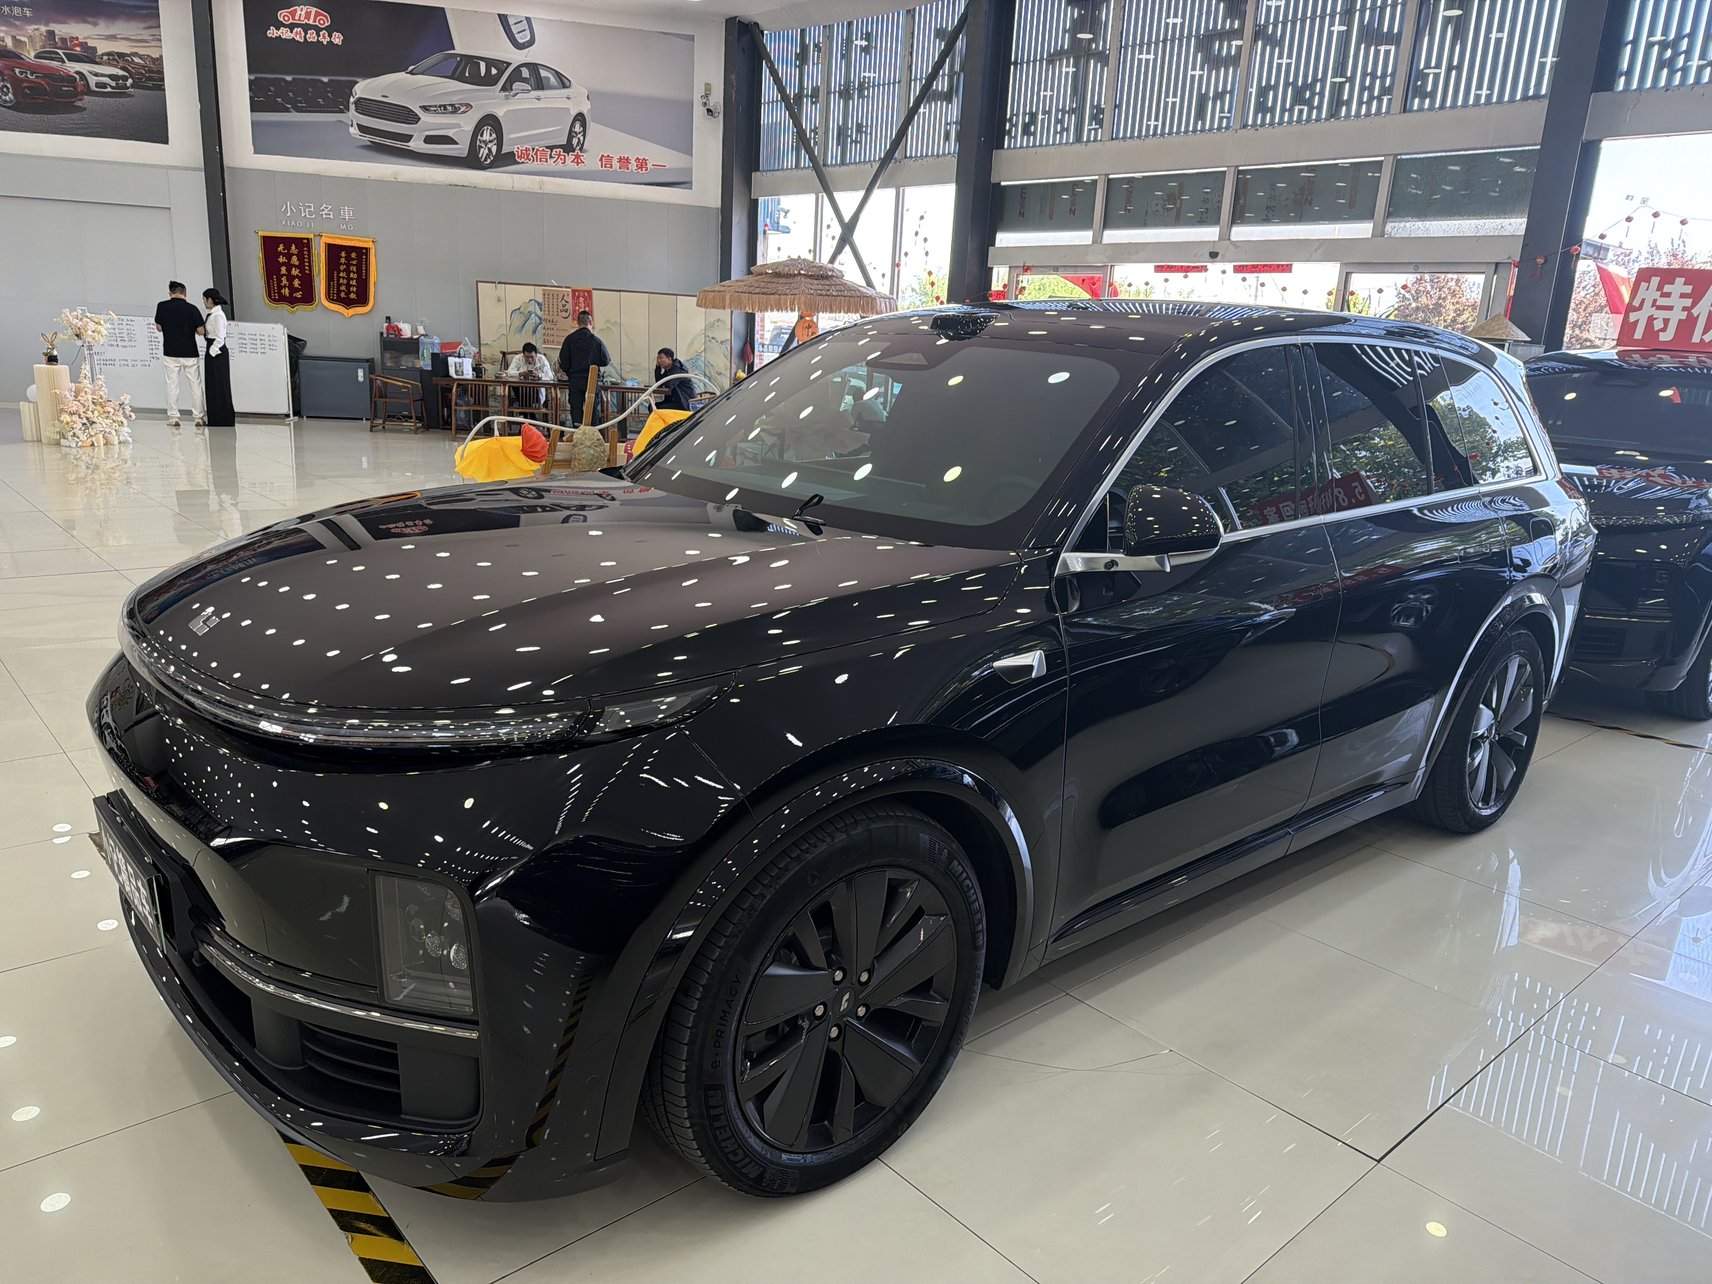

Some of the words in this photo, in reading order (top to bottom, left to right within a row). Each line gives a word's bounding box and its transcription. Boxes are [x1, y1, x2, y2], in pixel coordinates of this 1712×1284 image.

[1, 5, 33, 17] 水泡车
[267, 26, 343, 45] 小记精品车行
[514, 146, 586, 167] 诚信为本
[598, 153, 667, 172] 信誉第一
[281, 201, 355, 221] 小记名車
[281, 220, 303, 228] XIAO
[559, 294, 571, 319] 人品
[949, 858, 984, 947] MICHELIN
[705, 1087, 763, 1180] MICHELIN
